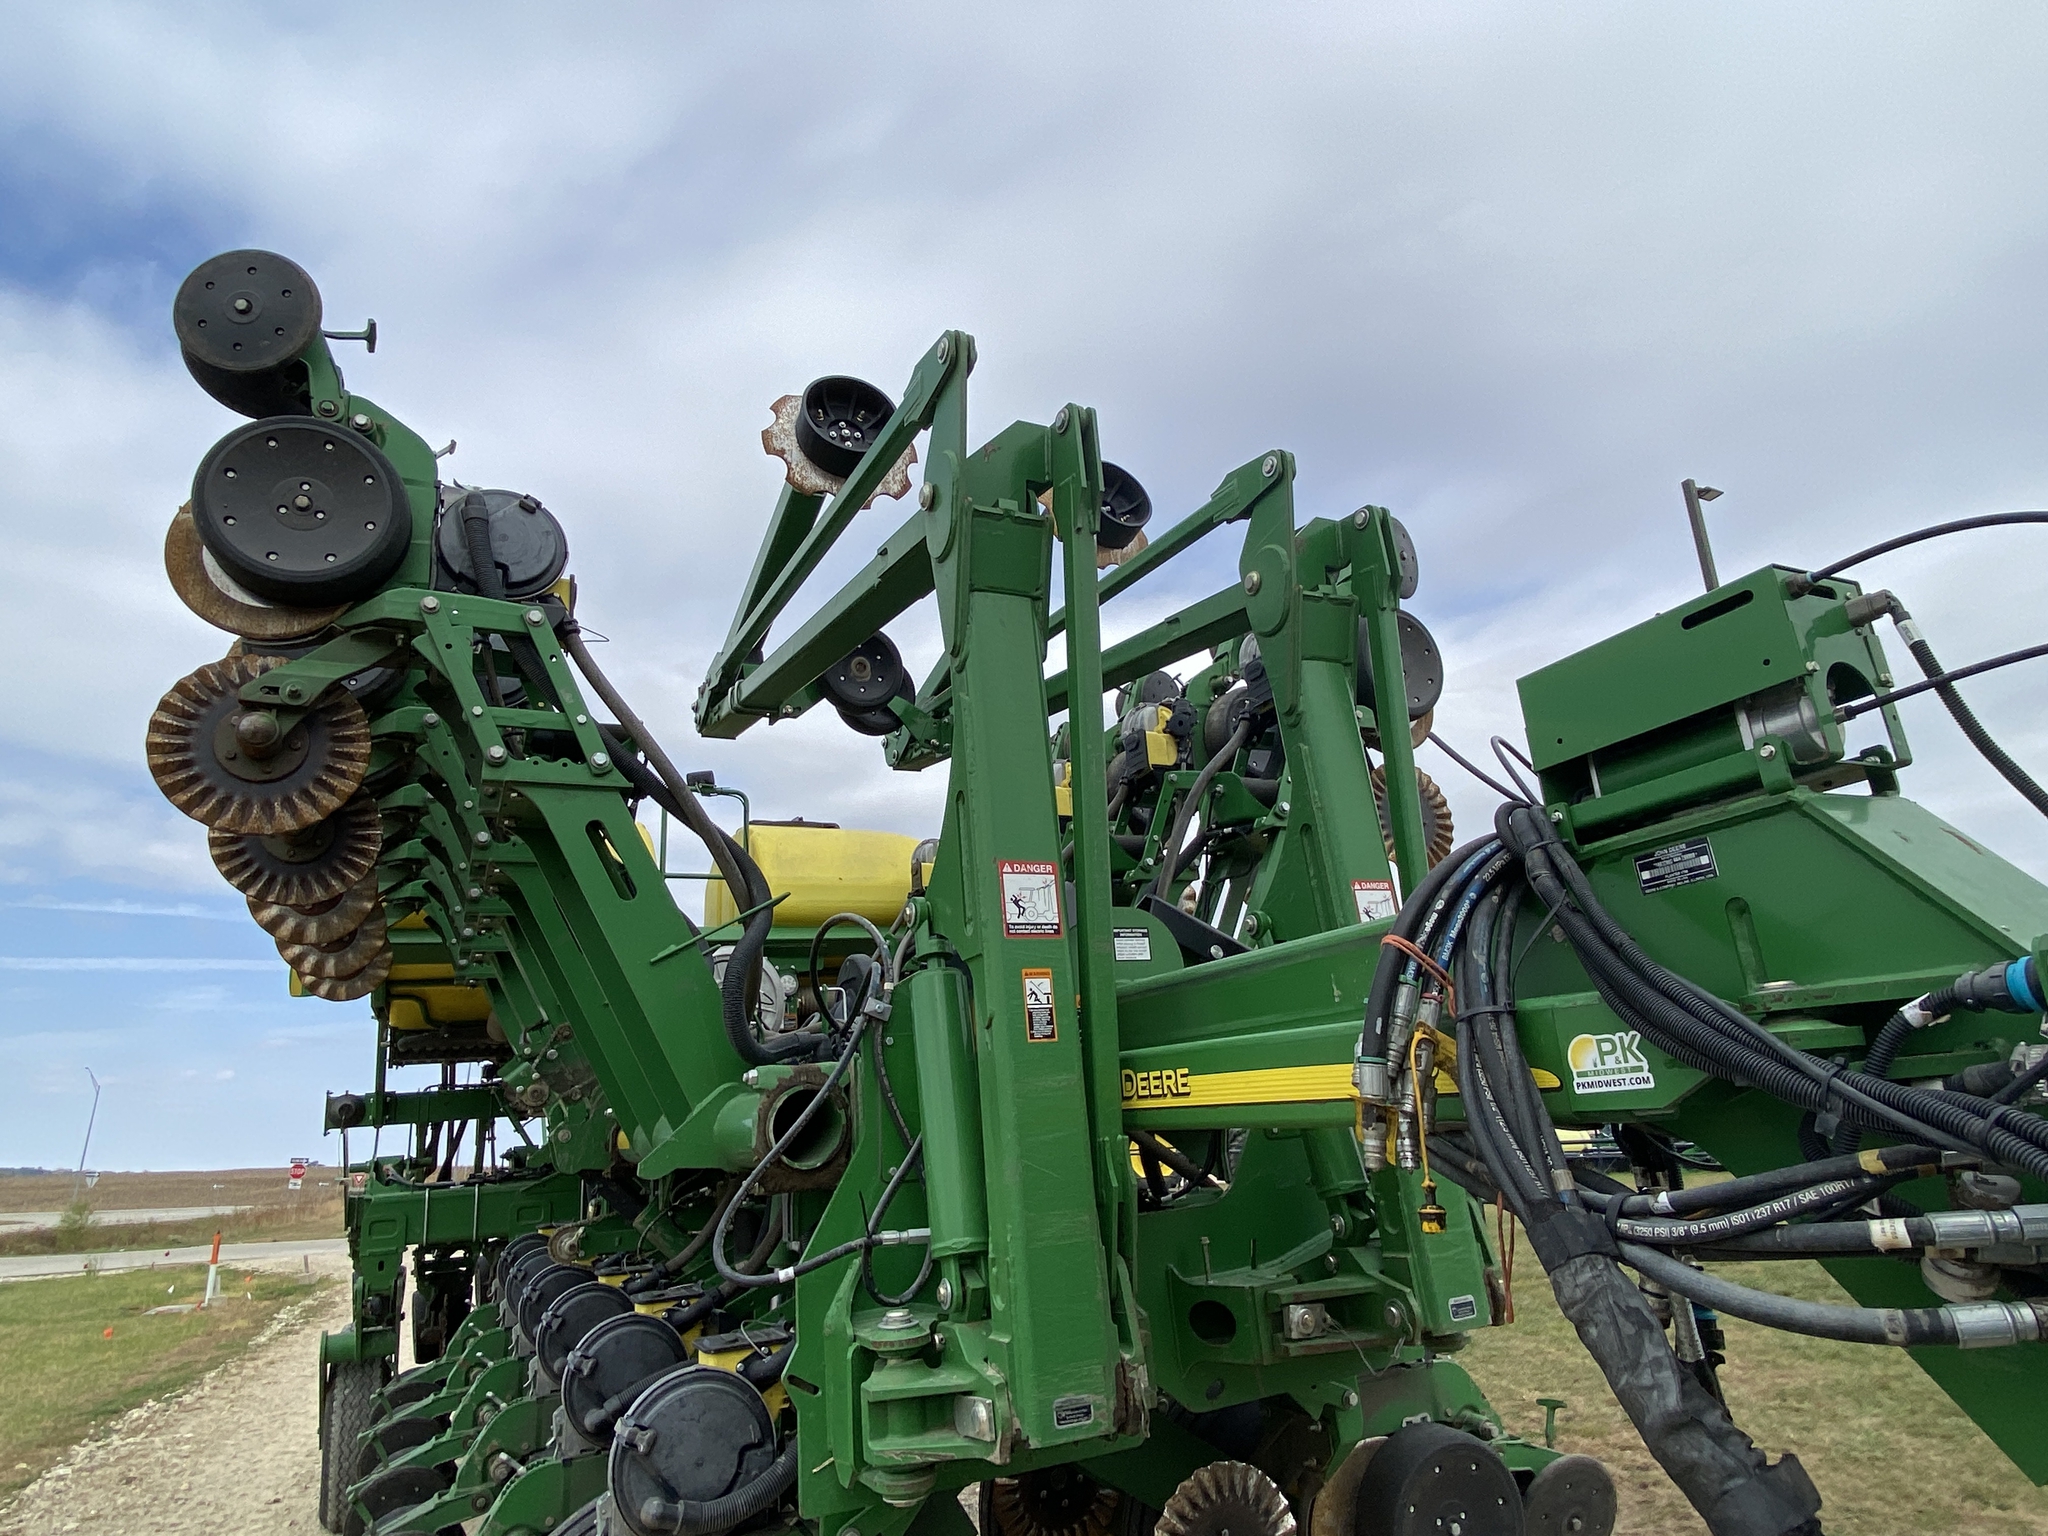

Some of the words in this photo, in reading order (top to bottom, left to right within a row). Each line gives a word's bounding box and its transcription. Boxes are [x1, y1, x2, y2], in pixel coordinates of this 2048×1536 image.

[1013, 863, 1053, 873] DANGER
[1361, 882, 1390, 890] DANGER
[1587, 1068, 1632, 1077] MIDWEST
[1121, 1067, 1191, 1098] DEERE
[1576, 1076, 1652, 1091] PKMIDWEST.COM
[1689, 1223, 1707, 1236] (9.5
[1708, 1217, 1730, 1231] mm)
[1772, 1198, 1791, 1213] R17
[1798, 1190, 1820, 1204] SAE
